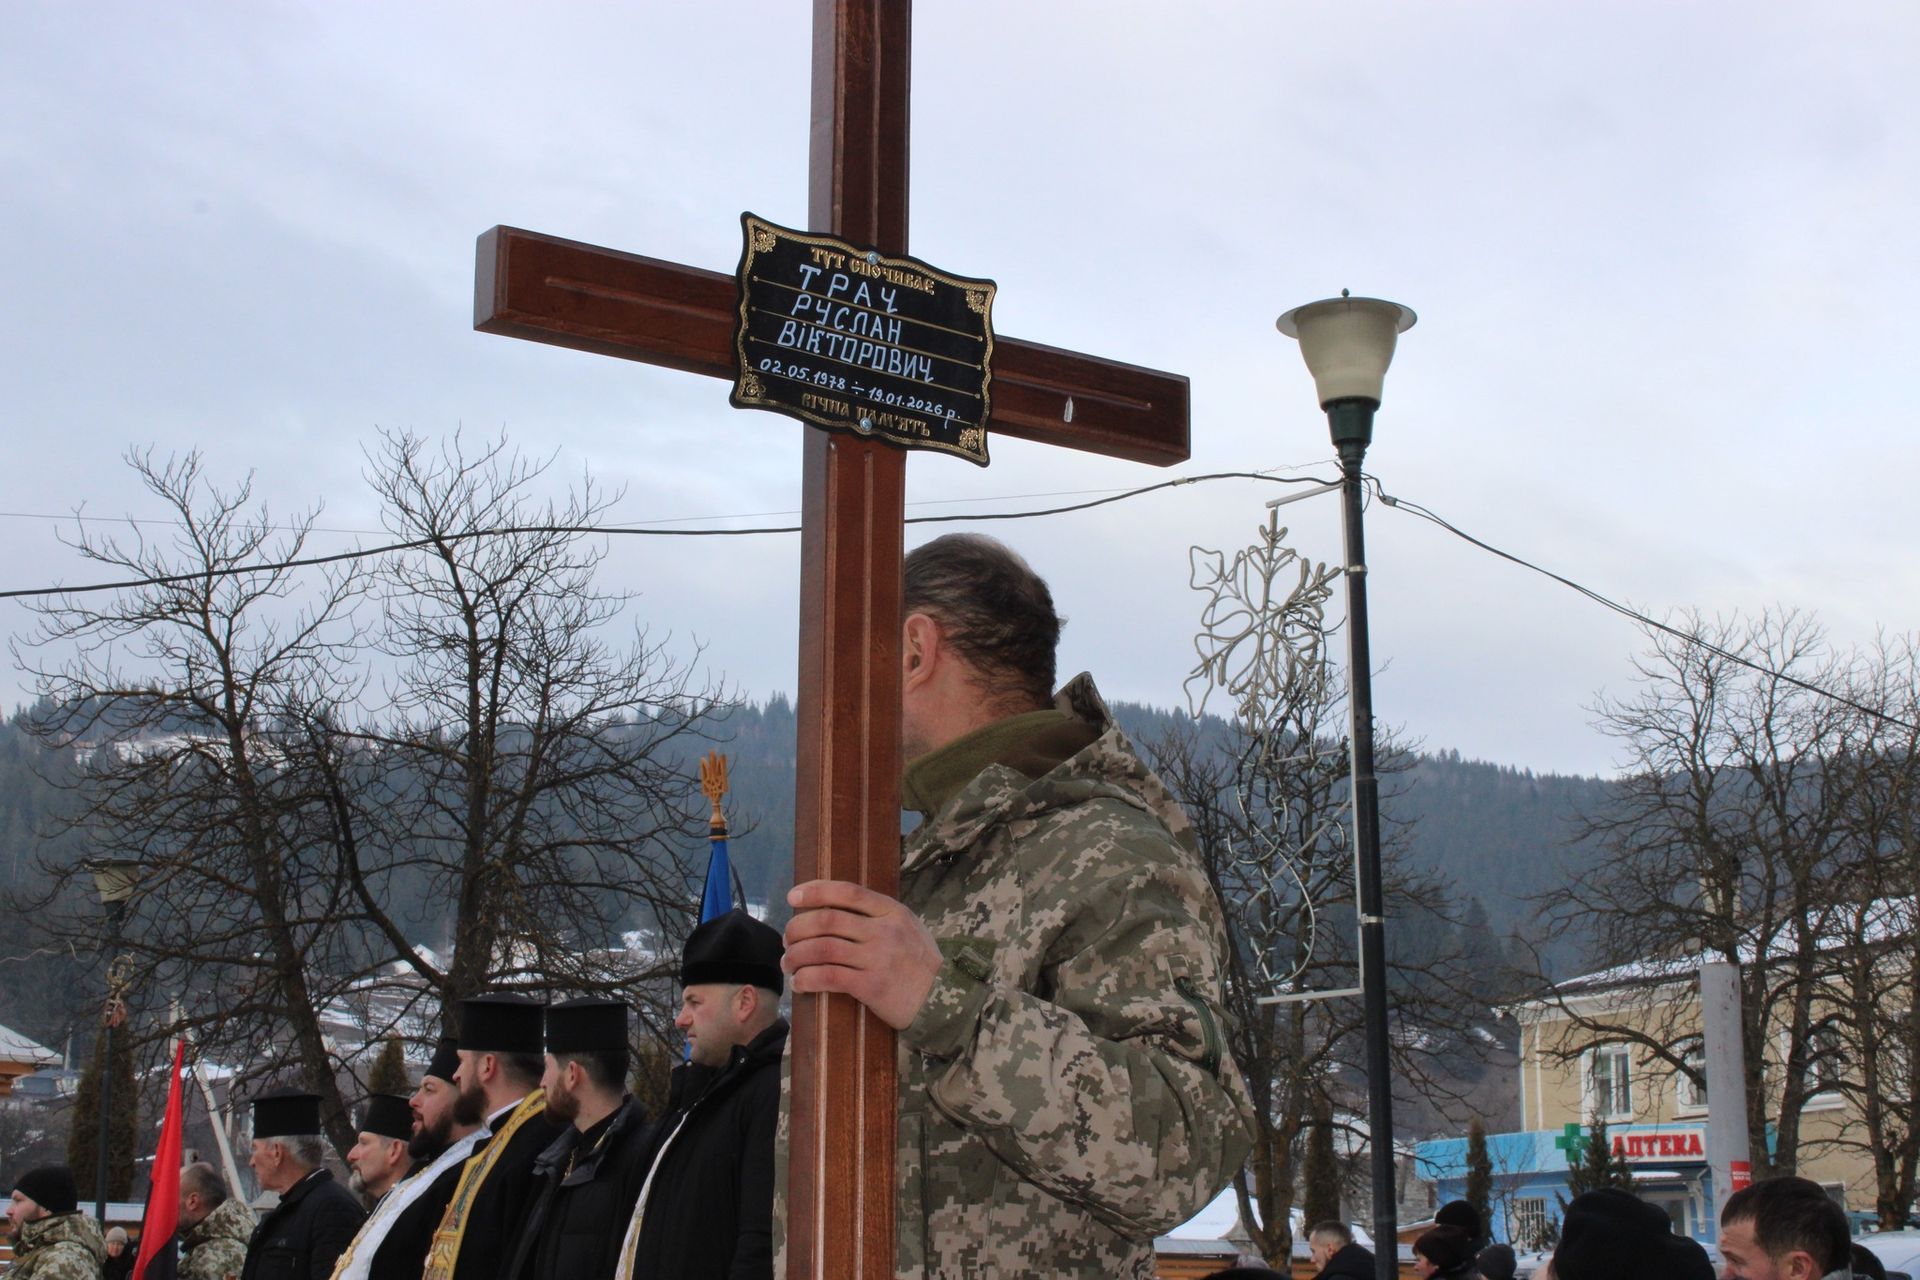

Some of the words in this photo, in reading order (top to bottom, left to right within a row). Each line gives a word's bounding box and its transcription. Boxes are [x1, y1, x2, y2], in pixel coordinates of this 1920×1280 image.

[810, 246, 845, 269] ТУТ
[800, 264, 898, 313] ТРАЧ
[791, 294, 902, 345] РУСЛАН
[760, 358, 846, 390] 02.05.1978
[869, 387, 943, 416] 19.01.2026
[1611, 1134, 1703, 1157] АПТЕКА
